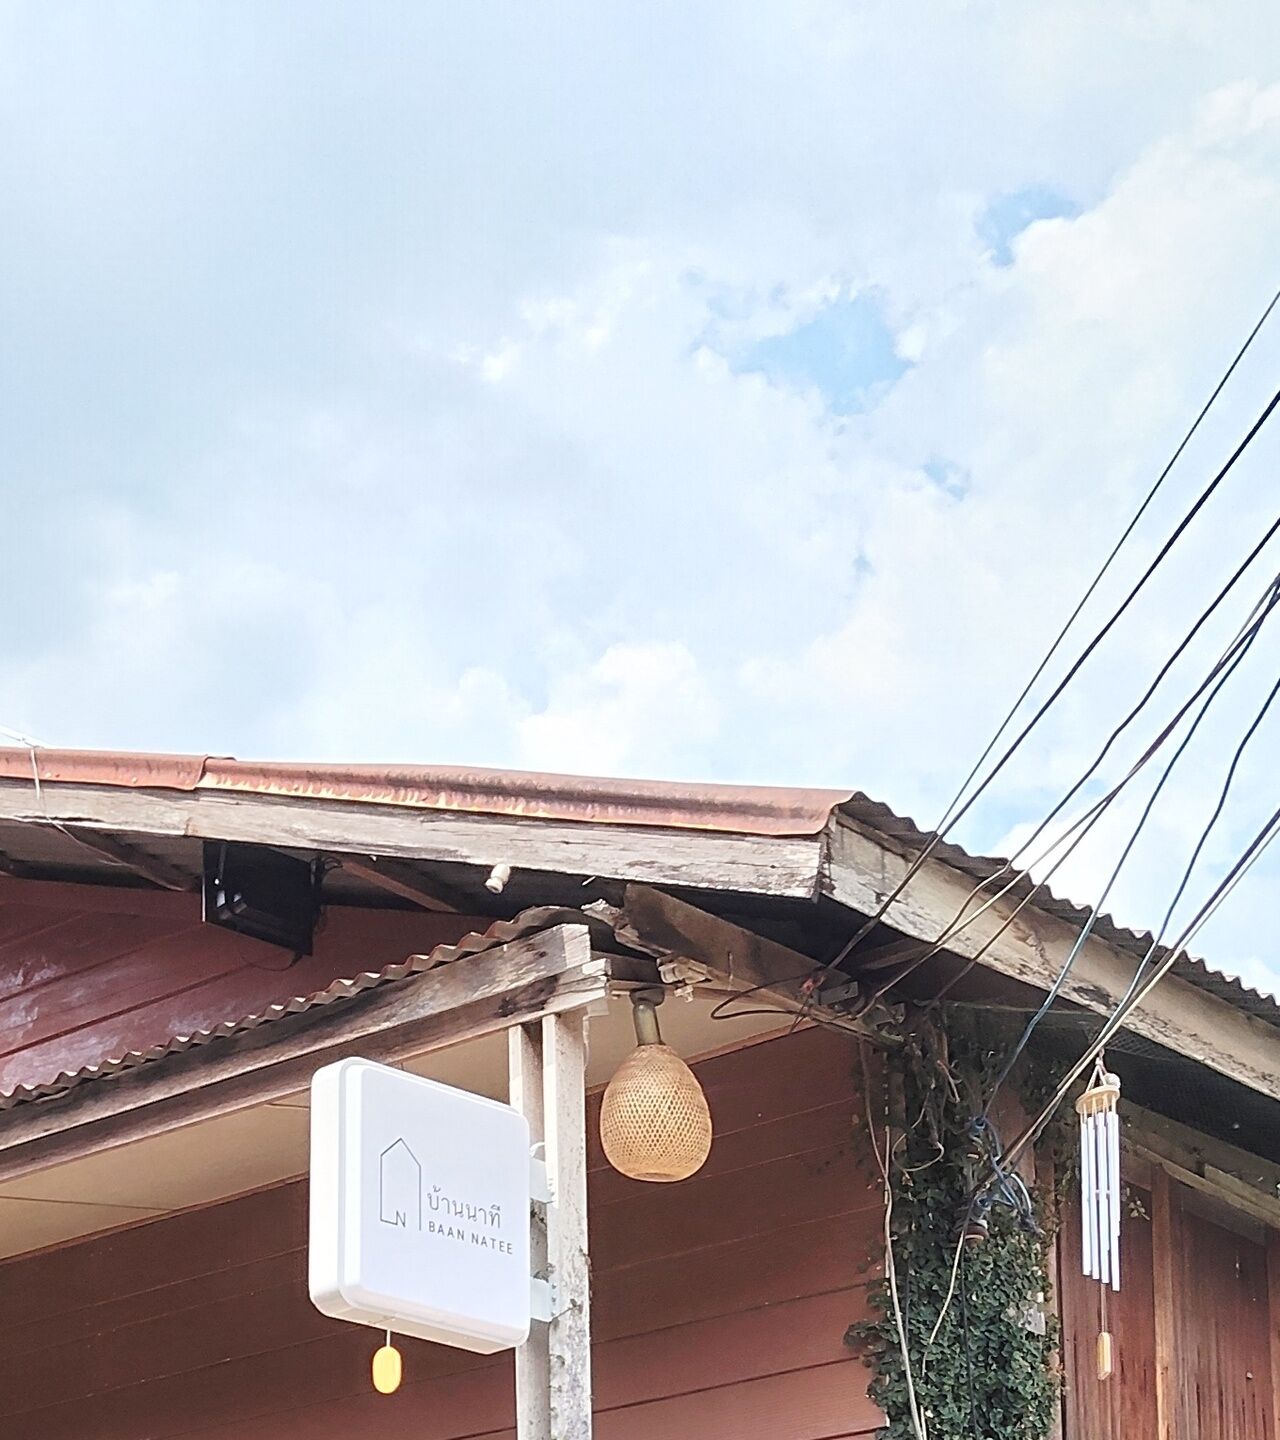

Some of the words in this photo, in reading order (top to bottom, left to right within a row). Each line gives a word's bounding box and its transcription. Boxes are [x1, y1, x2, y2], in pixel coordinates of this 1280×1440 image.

[427, 1184, 501, 1229] บ้านนาที
[428, 1220, 465, 1241] BAAN
[471, 1232, 513, 1255] NATEE
